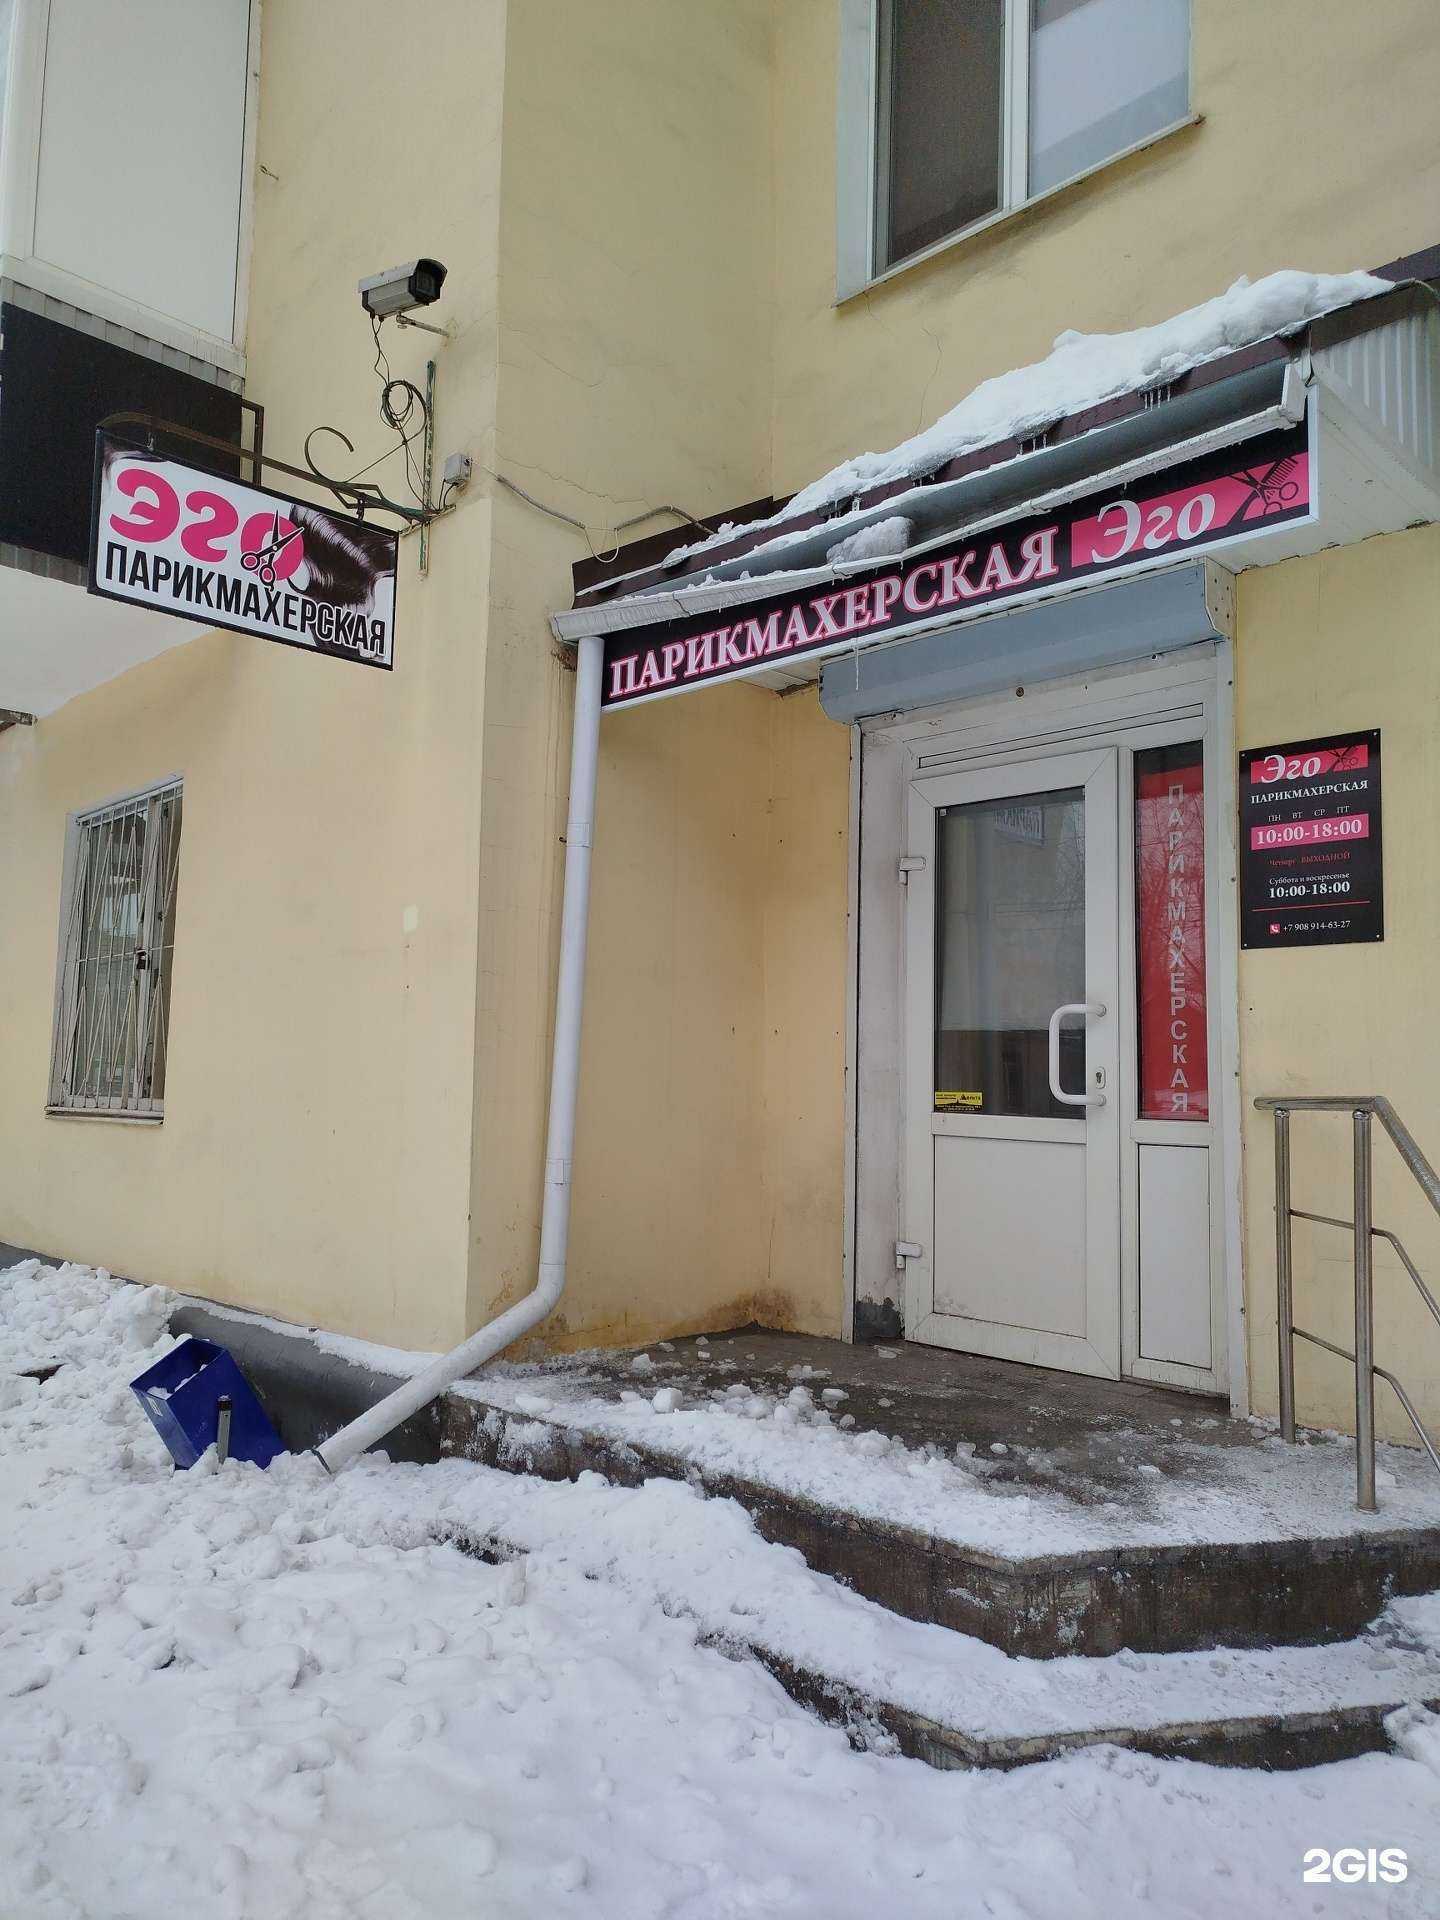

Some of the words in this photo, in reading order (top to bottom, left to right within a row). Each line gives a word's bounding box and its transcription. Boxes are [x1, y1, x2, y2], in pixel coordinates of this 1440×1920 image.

[105, 541, 386, 656] ПАРИКМАХЕРСКАЯ
[609, 525, 1059, 699] ПАРИКМАХЕРСКАЯ
[1091, 493, 1216, 564] Эго
[1260, 754, 1321, 784] Эго
[1250, 780, 1369, 804] ПАРИКМАХЕРСКАЯ
[1268, 814, 1281, 823] ПН
[1292, 811, 1304, 819] ВТ
[1314, 808, 1326, 817] СР
[1337, 805, 1350, 814] ПТ
[1257, 819, 1362, 845] 10:00-18:00
[1301, 850, 1350, 864] ВЫХОДНОЙ
[1269, 876, 1299, 886] Суббота
[1306, 873, 1350, 882] воскресенье
[1269, 881, 1350, 898] 10:00-18:00
[1283, 924, 1293, 932] +7
[1294, 923, 1309, 931] 908
[1167, 784, 1189, 1113] ПАРИКМАХЕРСКАЯ
